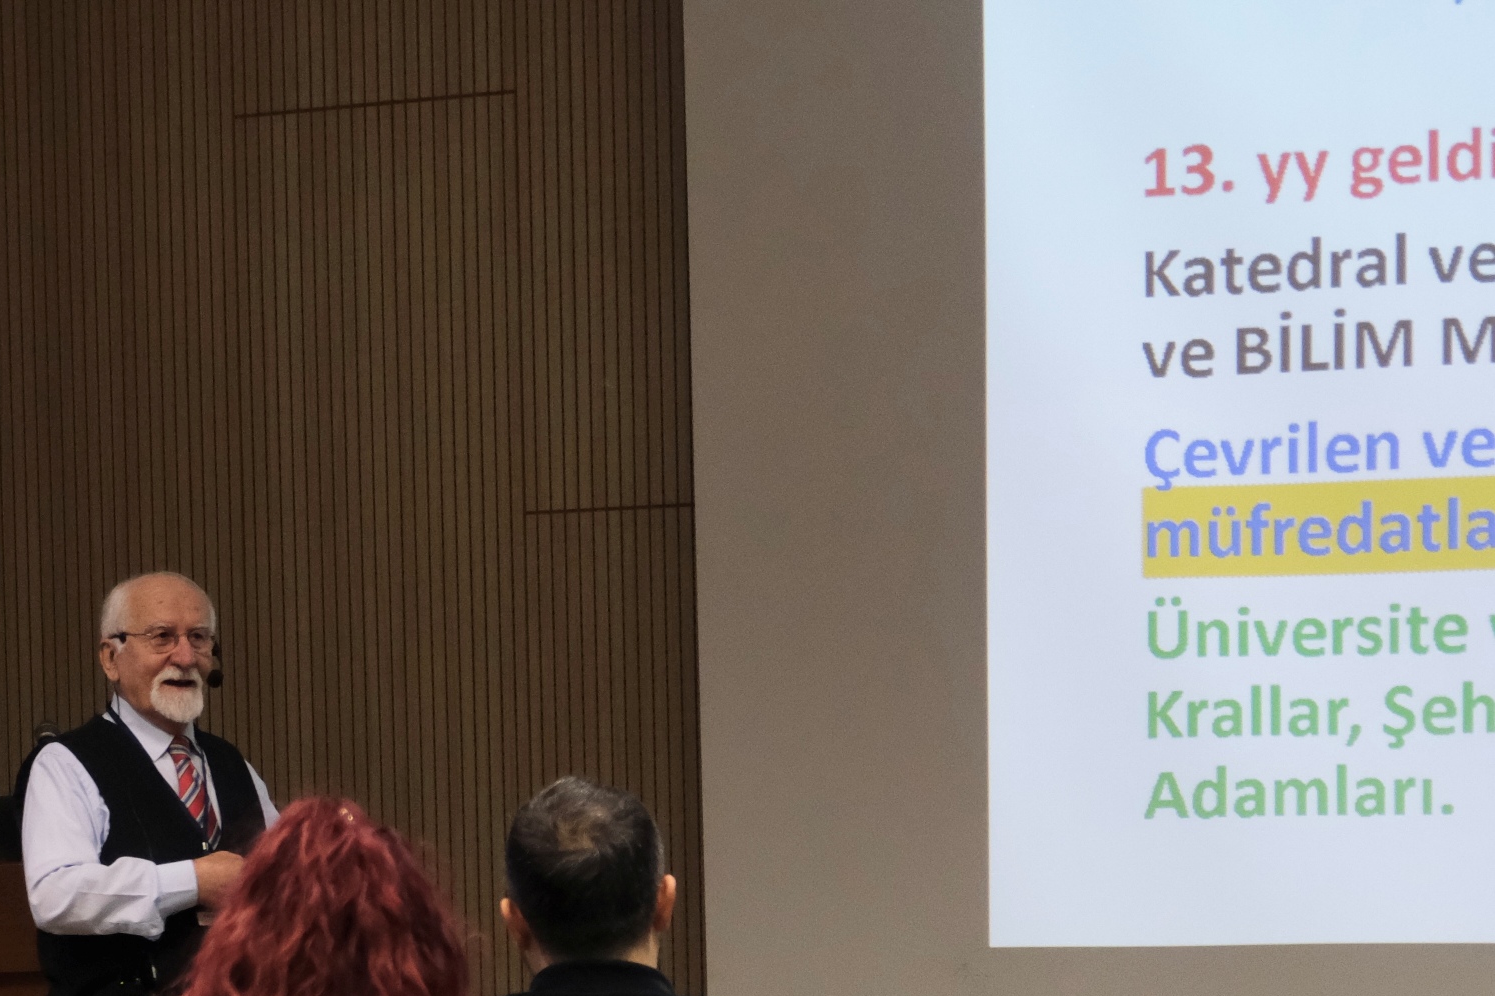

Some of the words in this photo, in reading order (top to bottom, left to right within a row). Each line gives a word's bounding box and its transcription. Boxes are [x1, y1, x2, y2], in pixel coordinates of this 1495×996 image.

[1143, 143, 1235, 198] 13.
[1256, 150, 1330, 205] yy
[1143, 232, 1408, 298] Katedral
[1428, 242, 1495, 284] ve
[1141, 337, 1217, 379] ve
[1235, 308, 1414, 376] BİLİM
[1143, 420, 1400, 491] Çevrilen
[1421, 427, 1495, 469] ve
[1145, 497, 1495, 559] müfredatla
[1146, 596, 1470, 660] Üniversite
[1146, 684, 1362, 748] Krallar,
[1382, 680, 1495, 749] Şeh
[1143, 763, 1455, 820] Adamları.
